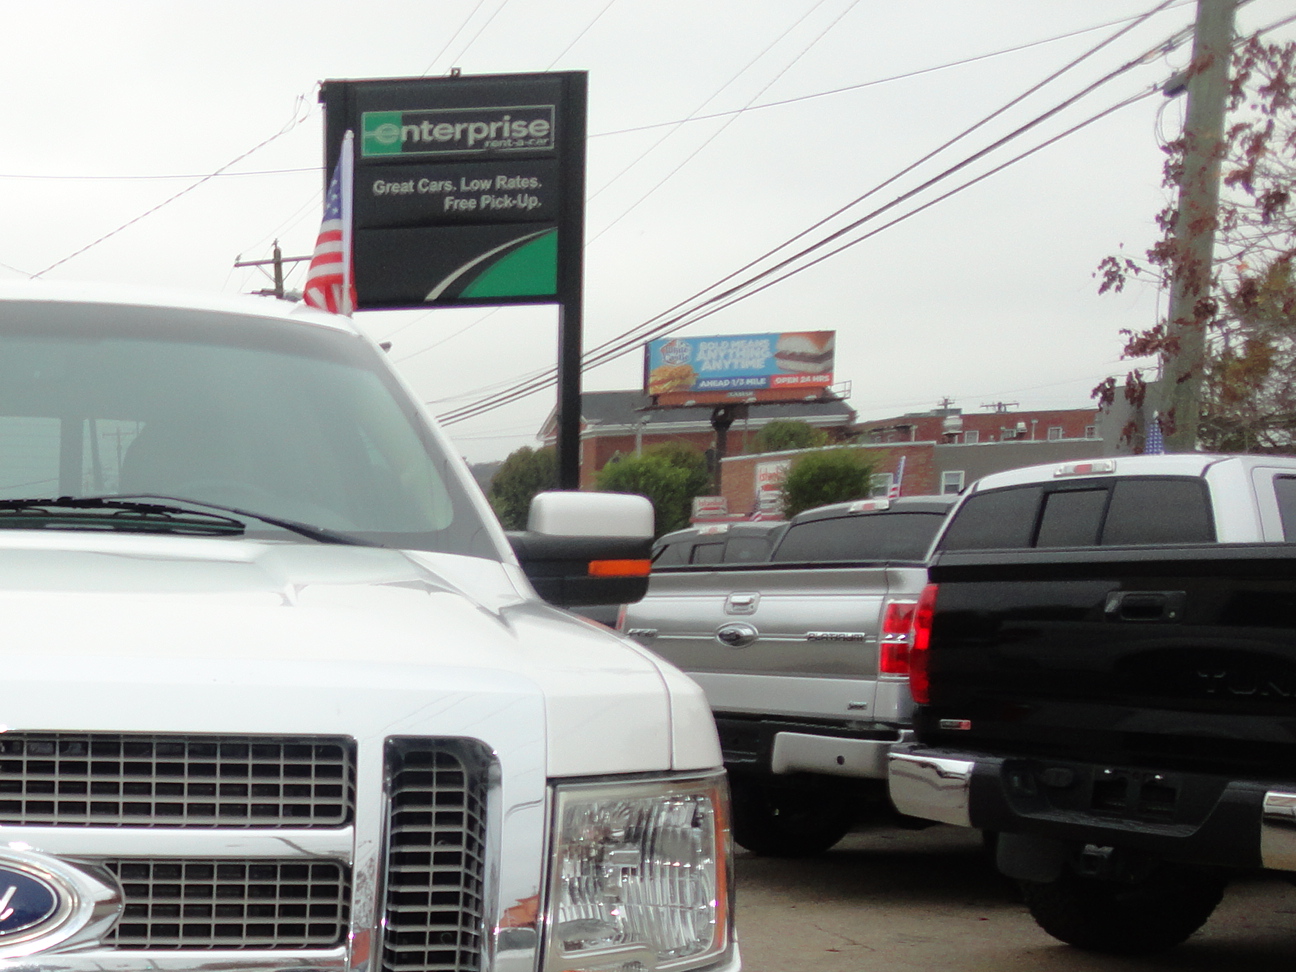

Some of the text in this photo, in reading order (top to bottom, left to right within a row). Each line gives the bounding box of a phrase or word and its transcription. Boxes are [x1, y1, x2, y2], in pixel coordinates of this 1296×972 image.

[375, 115, 550, 147] enterprise
[485, 137, 549, 148] rent-a-car
[373, 174, 543, 195] Great Cars. Low Rates.
[444, 193, 543, 212] Free Pick-Up.
[699, 380, 730, 388] AHEAD
[745, 376, 767, 386] MILE
[774, 374, 830, 385] OPEN 24 HRS
